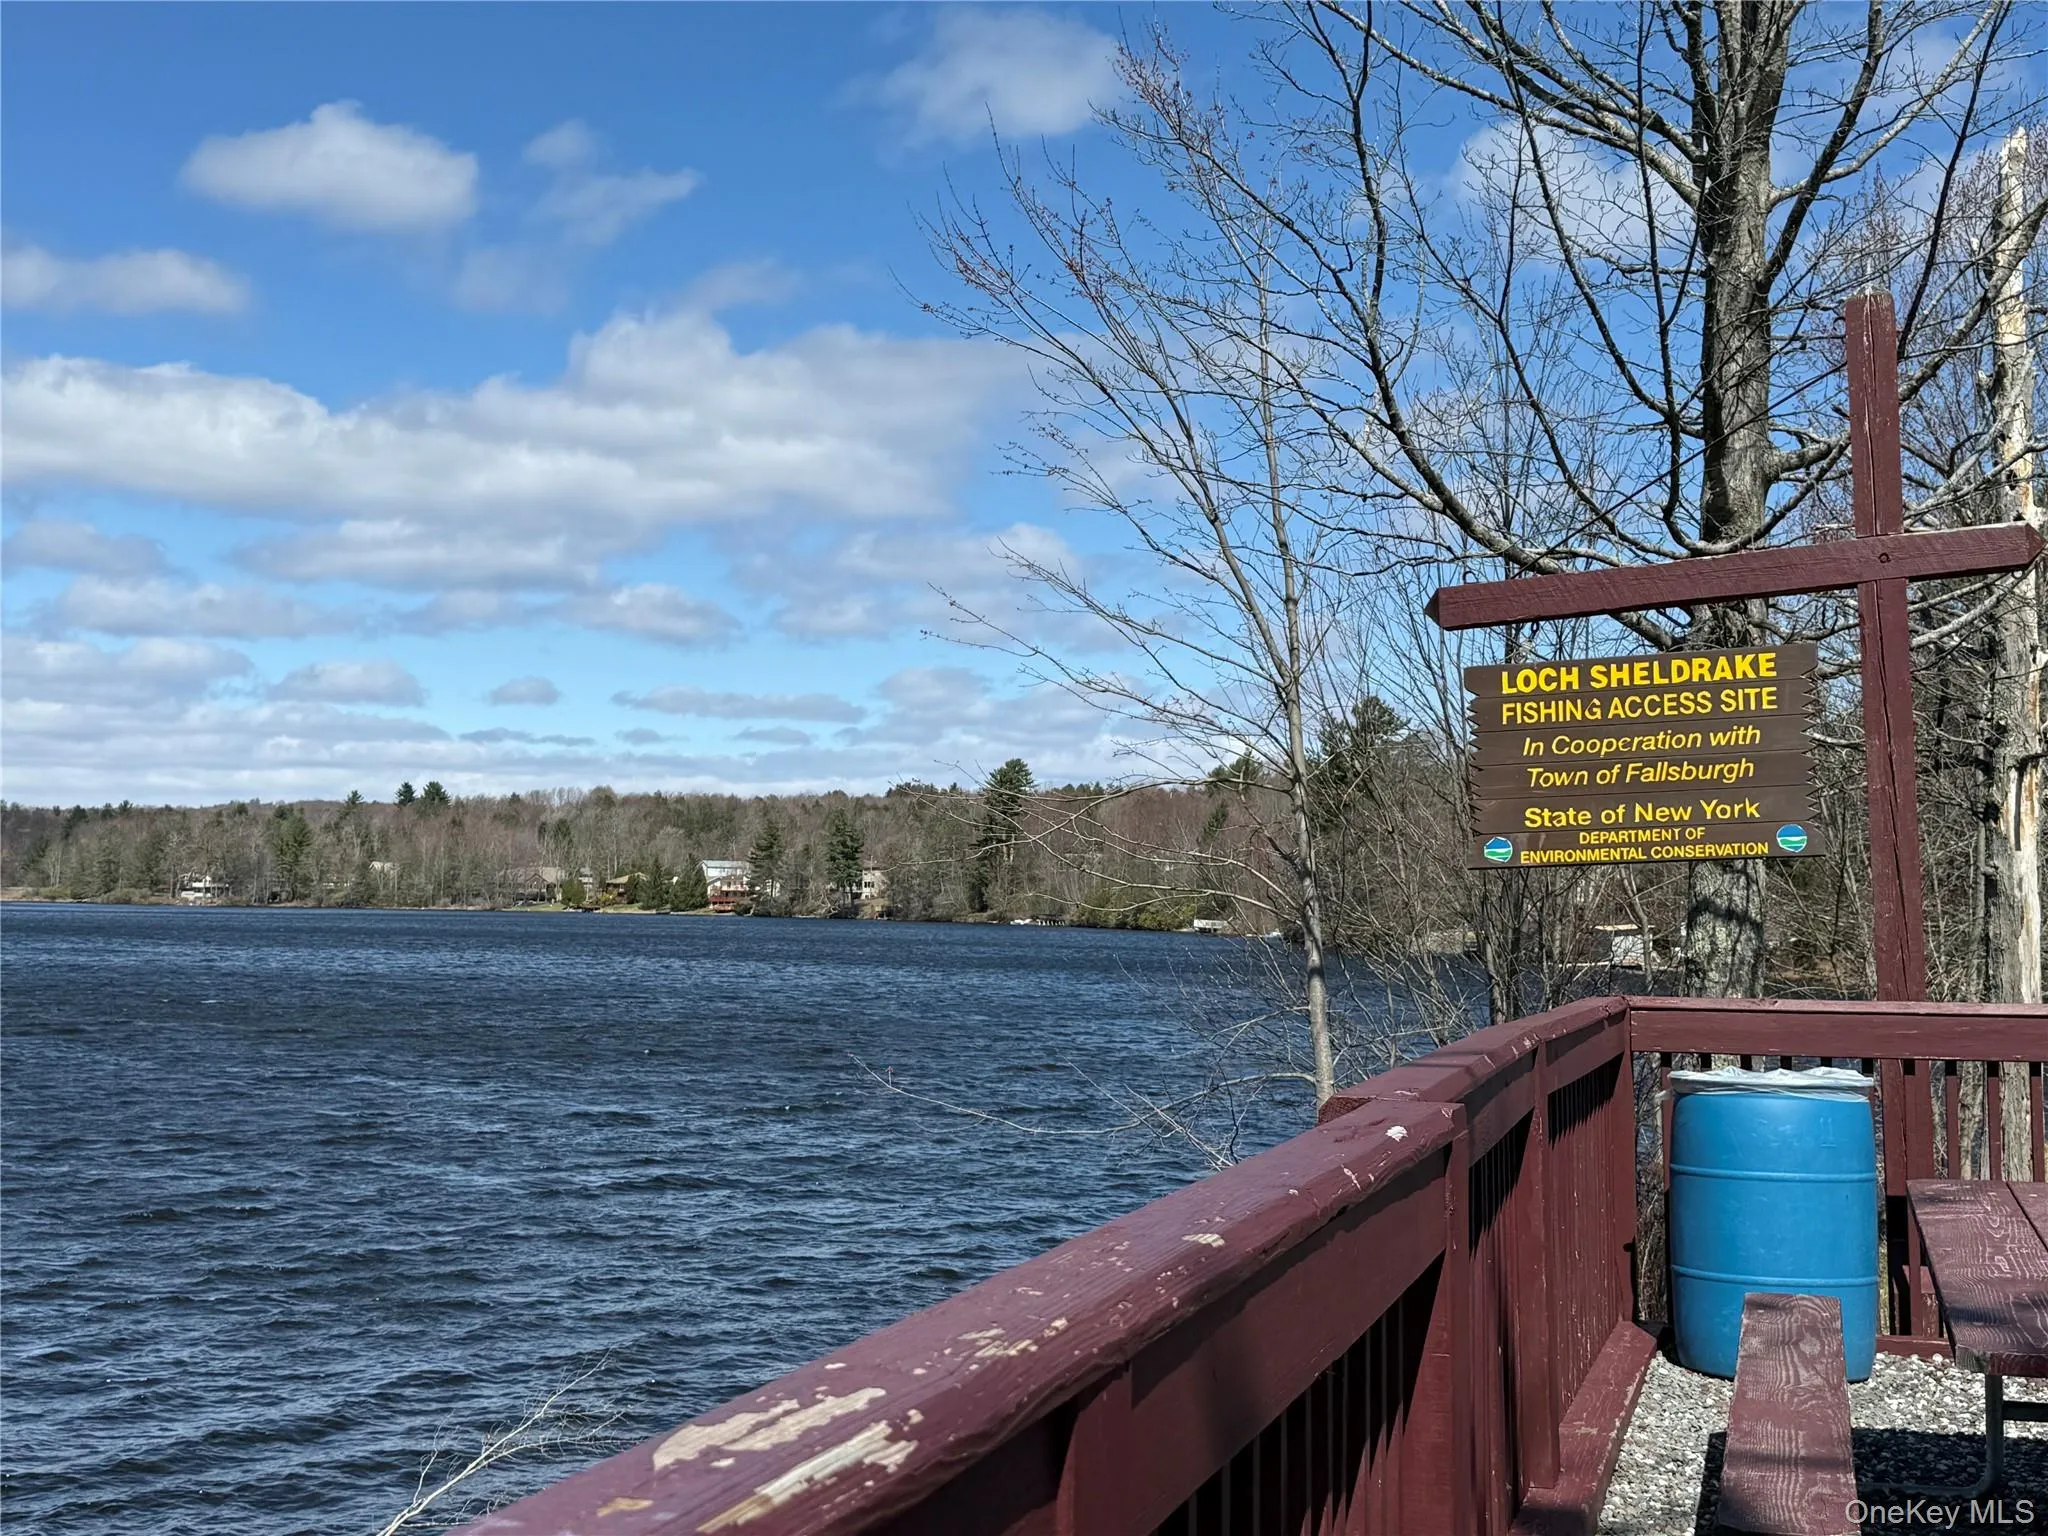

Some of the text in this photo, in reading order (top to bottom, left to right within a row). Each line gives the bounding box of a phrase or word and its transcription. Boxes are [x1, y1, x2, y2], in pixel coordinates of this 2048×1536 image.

[1502, 653, 1776, 694] LOCH SHELDRAKE
[1503, 686, 1778, 724] FISHING ACCESS SITE
[1524, 726, 1760, 757] In Cooperation with
[1528, 759, 1753, 787] Town of Fallsburgh
[1525, 798, 1761, 827] State of New York
[1580, 827, 1705, 844] DEPARTMENT OF
[1521, 843, 1768, 864] ENVIRONMENTAL CONSERVATION
